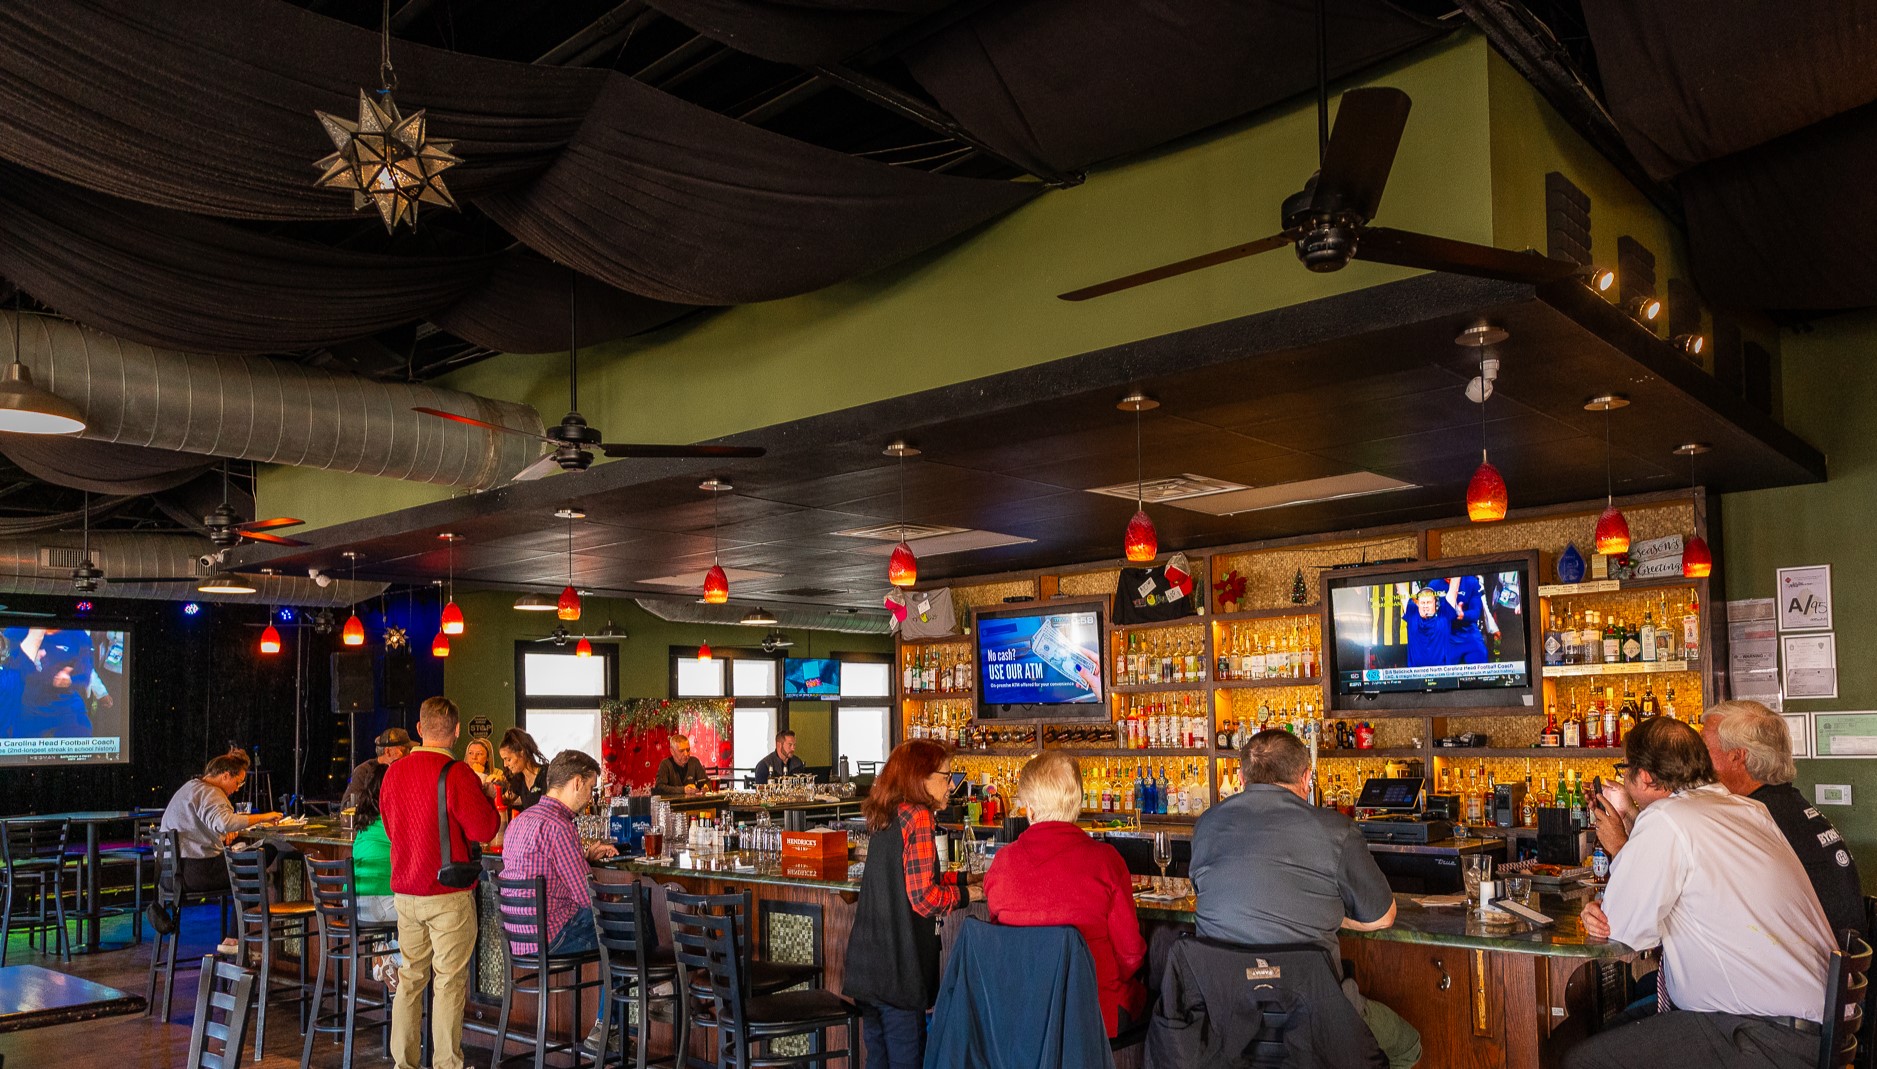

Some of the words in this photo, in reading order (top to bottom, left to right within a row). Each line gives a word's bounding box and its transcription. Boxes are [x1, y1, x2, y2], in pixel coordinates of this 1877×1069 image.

[988, 649, 996, 662] No
[998, 648, 1016, 660] cash?
[989, 664, 1004, 680] USE
[1006, 663, 1023, 679] OUR
[1025, 662, 1043, 679] ATM
